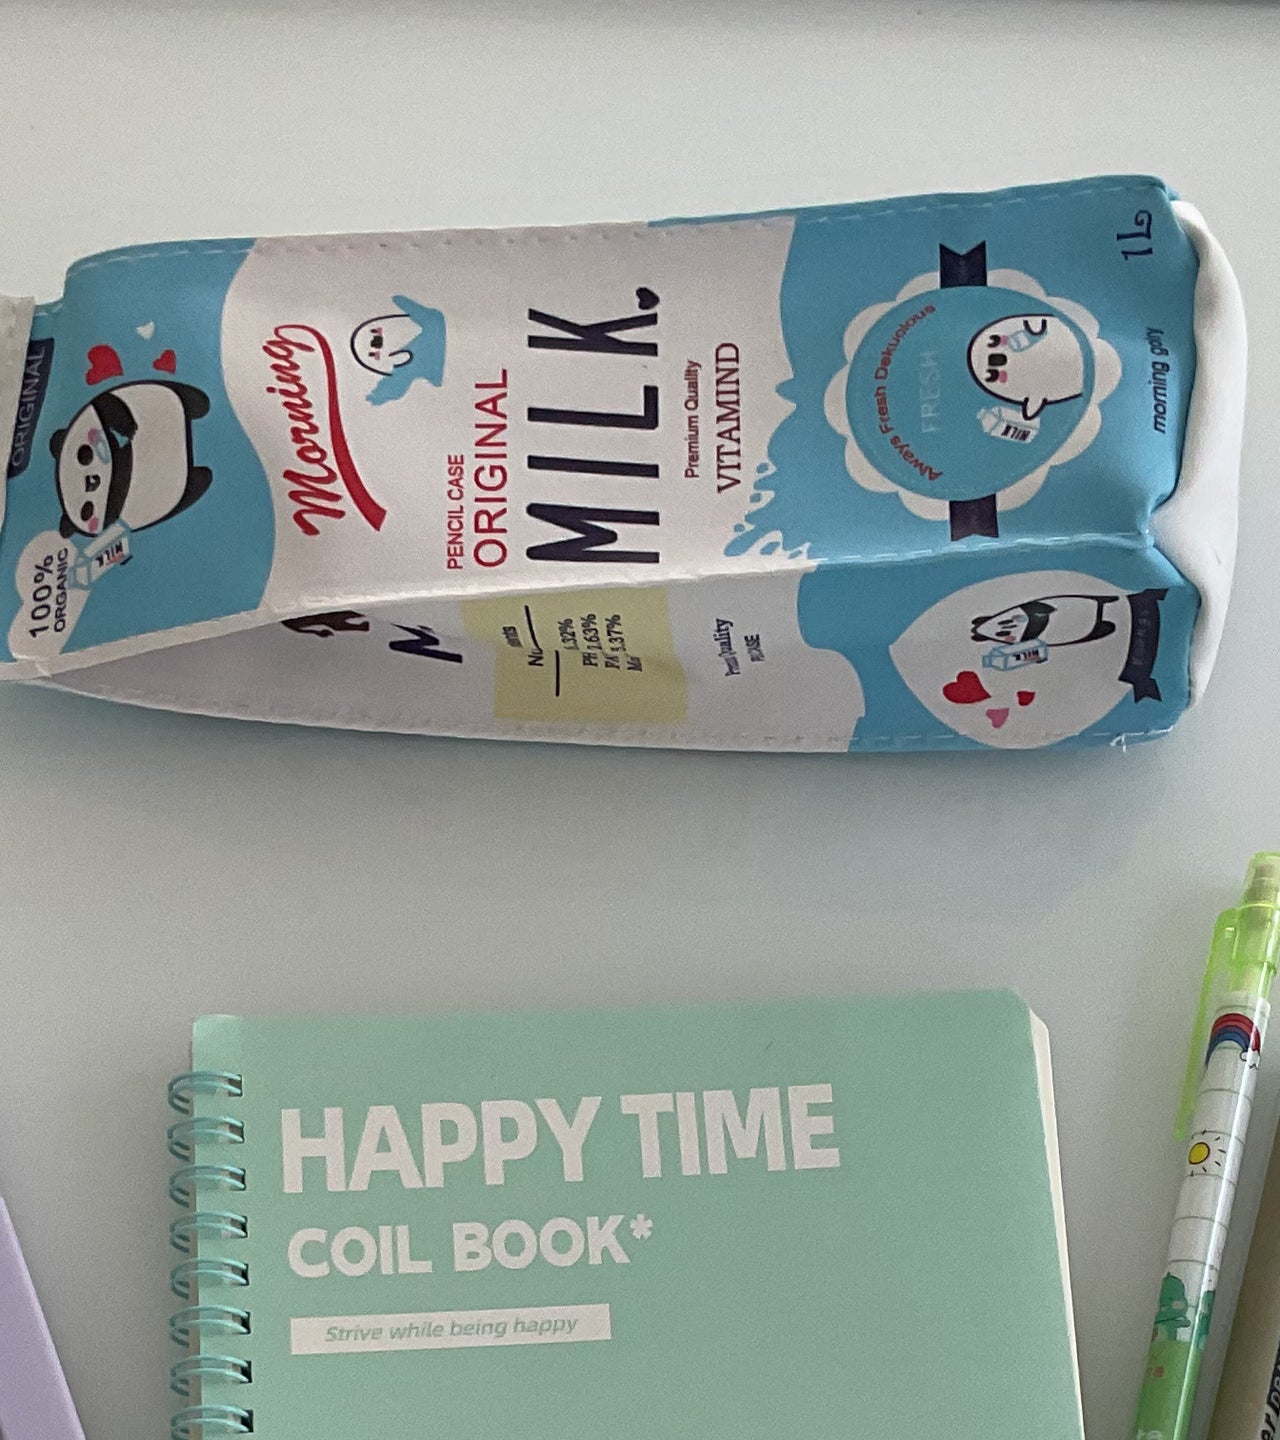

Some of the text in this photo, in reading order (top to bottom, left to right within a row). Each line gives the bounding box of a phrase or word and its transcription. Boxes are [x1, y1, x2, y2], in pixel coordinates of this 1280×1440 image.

[10, 346, 46, 469] ORIGINAL
[263, 323, 387, 537] Morning
[684, 359, 704, 479] Premium Quality
[716, 342, 741, 493] VITAMIND
[874, 386, 894, 434] Fresh
[919, 351, 941, 434] FRESH
[1148, 360, 1169, 435] morning
[474, 367, 510, 568] ORIGINAL
[889, 435, 943, 483] Always
[447, 453, 464, 571] PENCIL CASE
[27, 555, 55, 639] 100%
[53, 548, 70, 632] ORGANIC
[281, 1083, 840, 1193] HAPPY TIME
[287, 1225, 432, 1278] COIL
[325, 1313, 578, 1343] Strive while being happy
